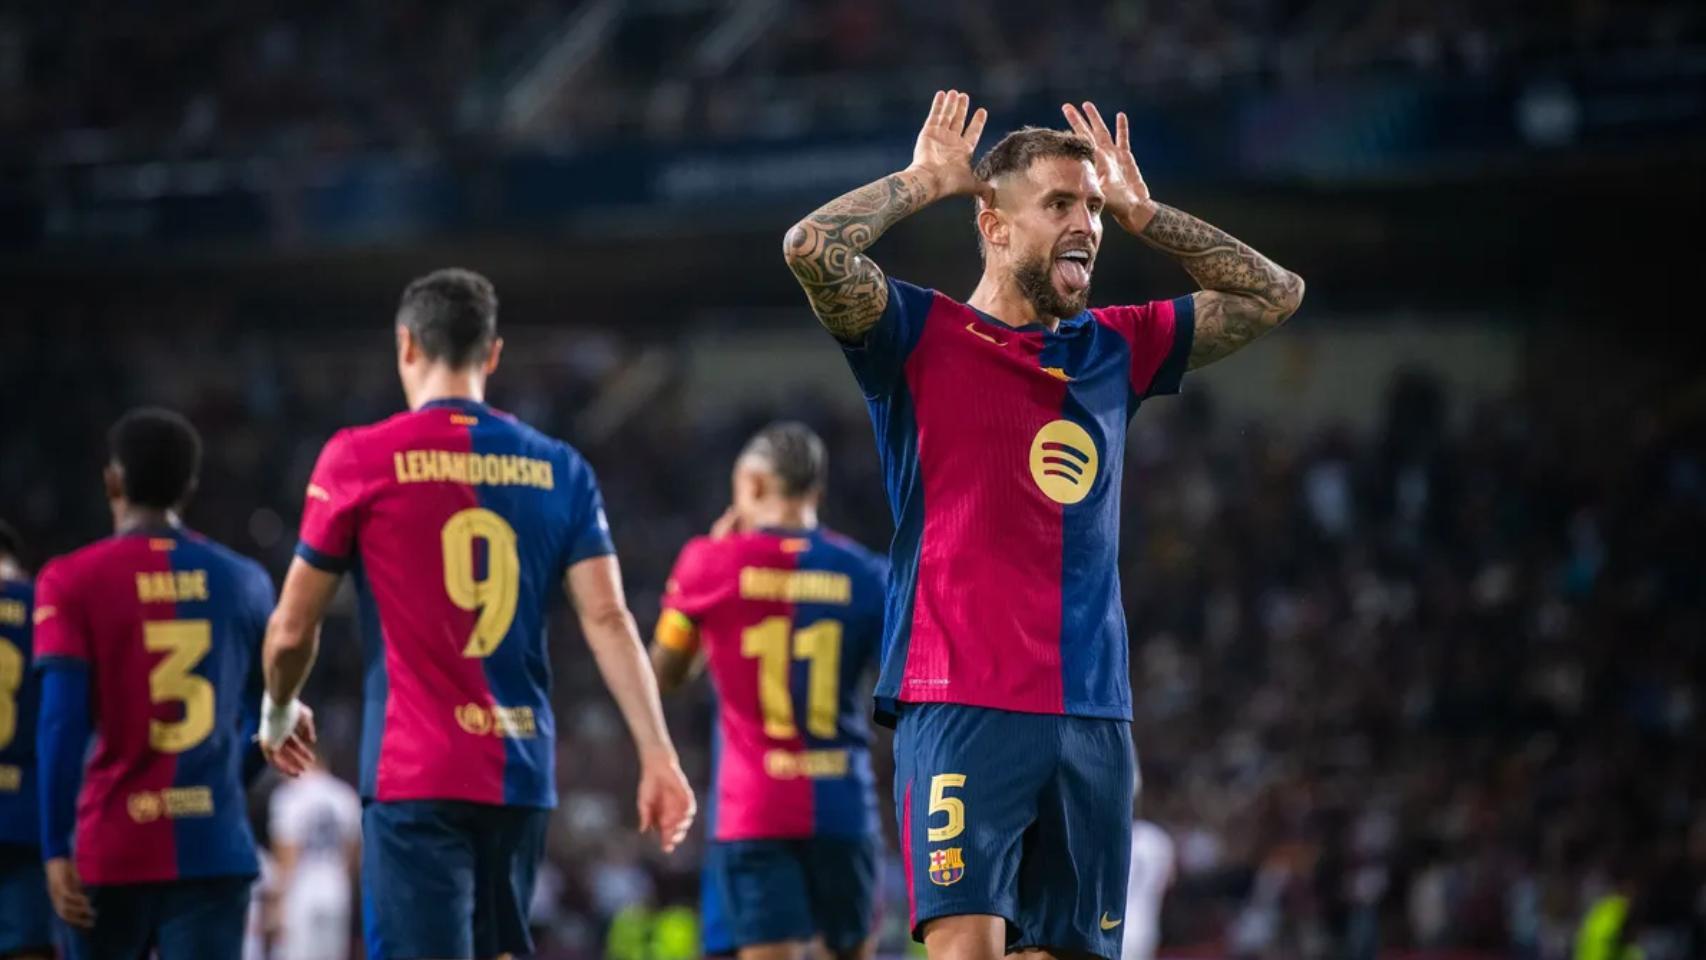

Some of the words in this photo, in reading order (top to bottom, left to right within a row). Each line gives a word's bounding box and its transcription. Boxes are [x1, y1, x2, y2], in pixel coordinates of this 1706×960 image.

[394, 450, 554, 490] LEWANDOWSKI
[441, 508, 520, 658] 9
[143, 619, 215, 753] 3
[741, 616, 843, 740] 11
[928, 774, 966, 842] 5
